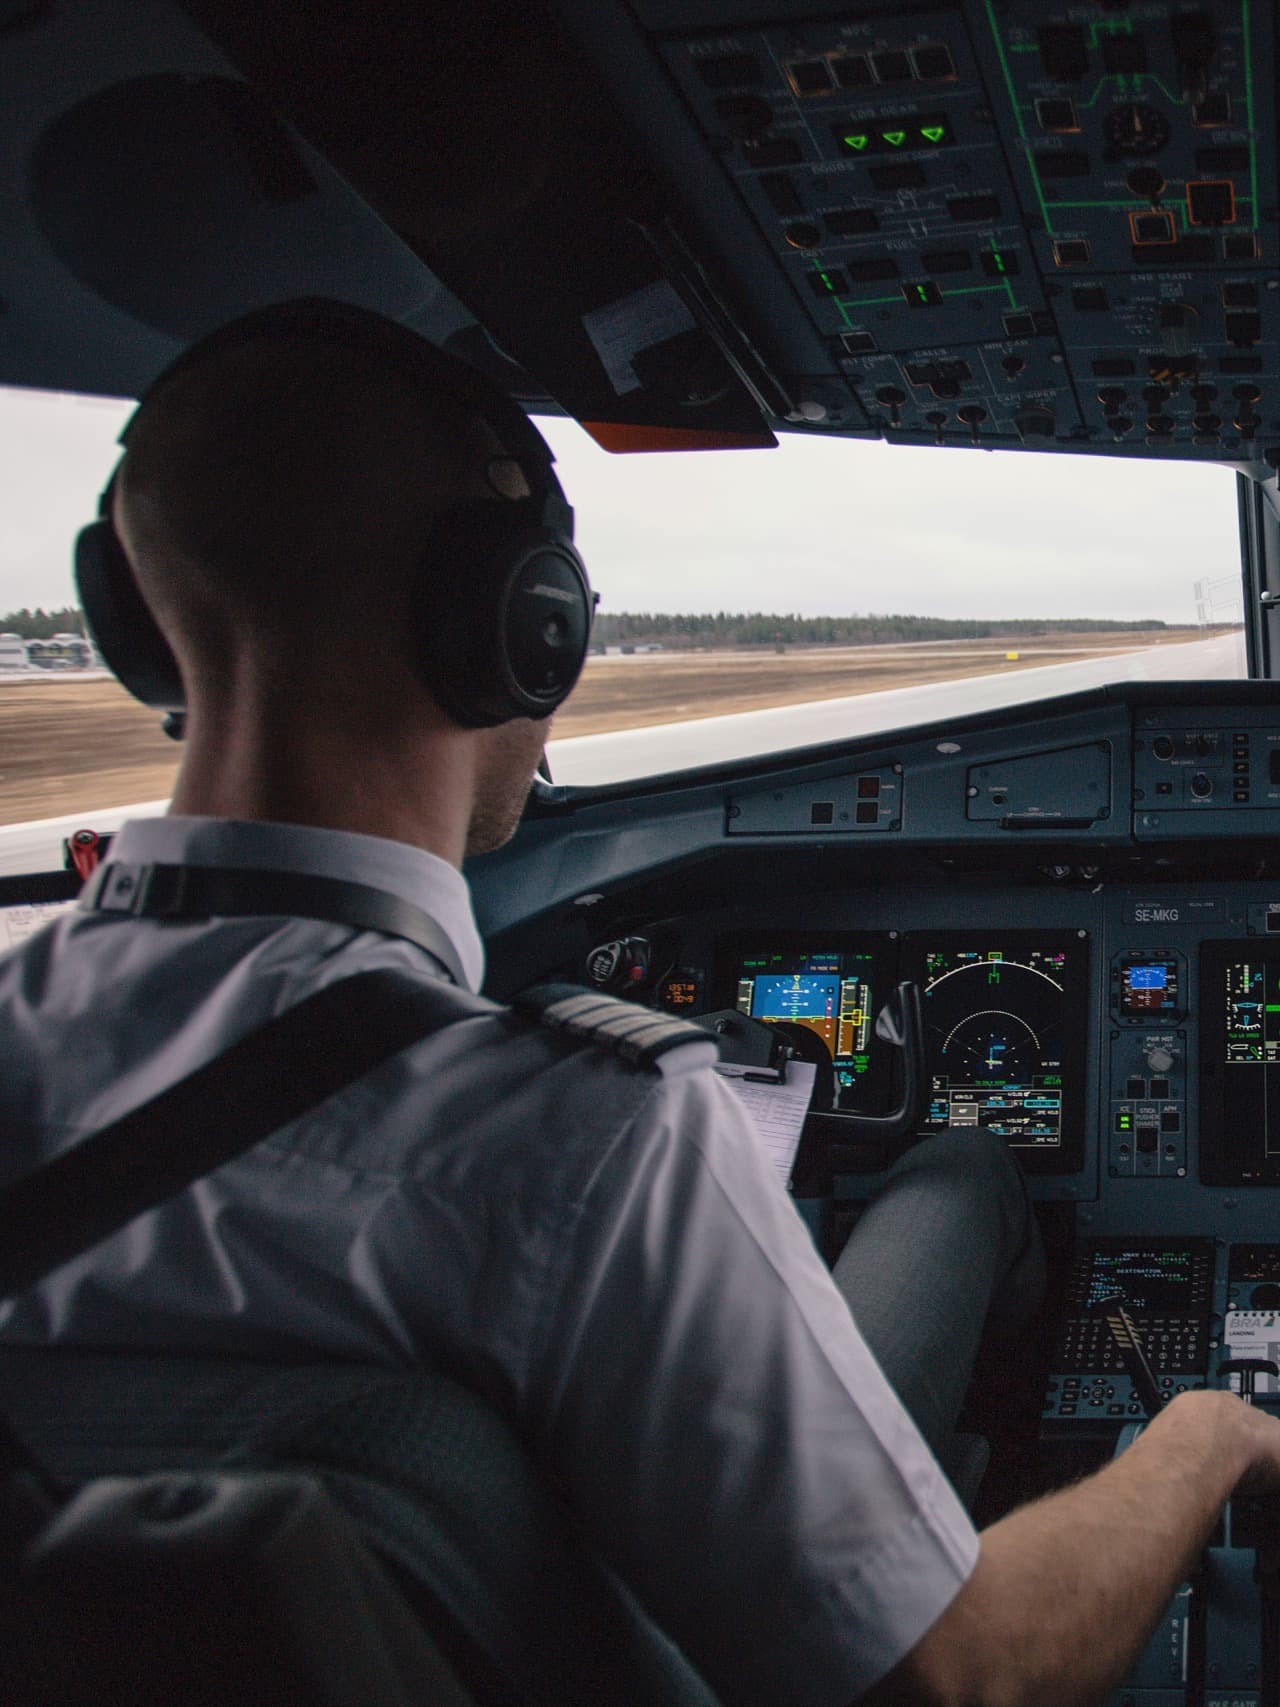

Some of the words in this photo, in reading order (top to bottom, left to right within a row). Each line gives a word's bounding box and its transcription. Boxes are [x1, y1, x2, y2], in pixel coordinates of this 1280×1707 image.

[1157, 272, 1193, 281] START
[1135, 909, 1179, 922] SE-MKG
[1230, 1317, 1262, 1328] BRA
